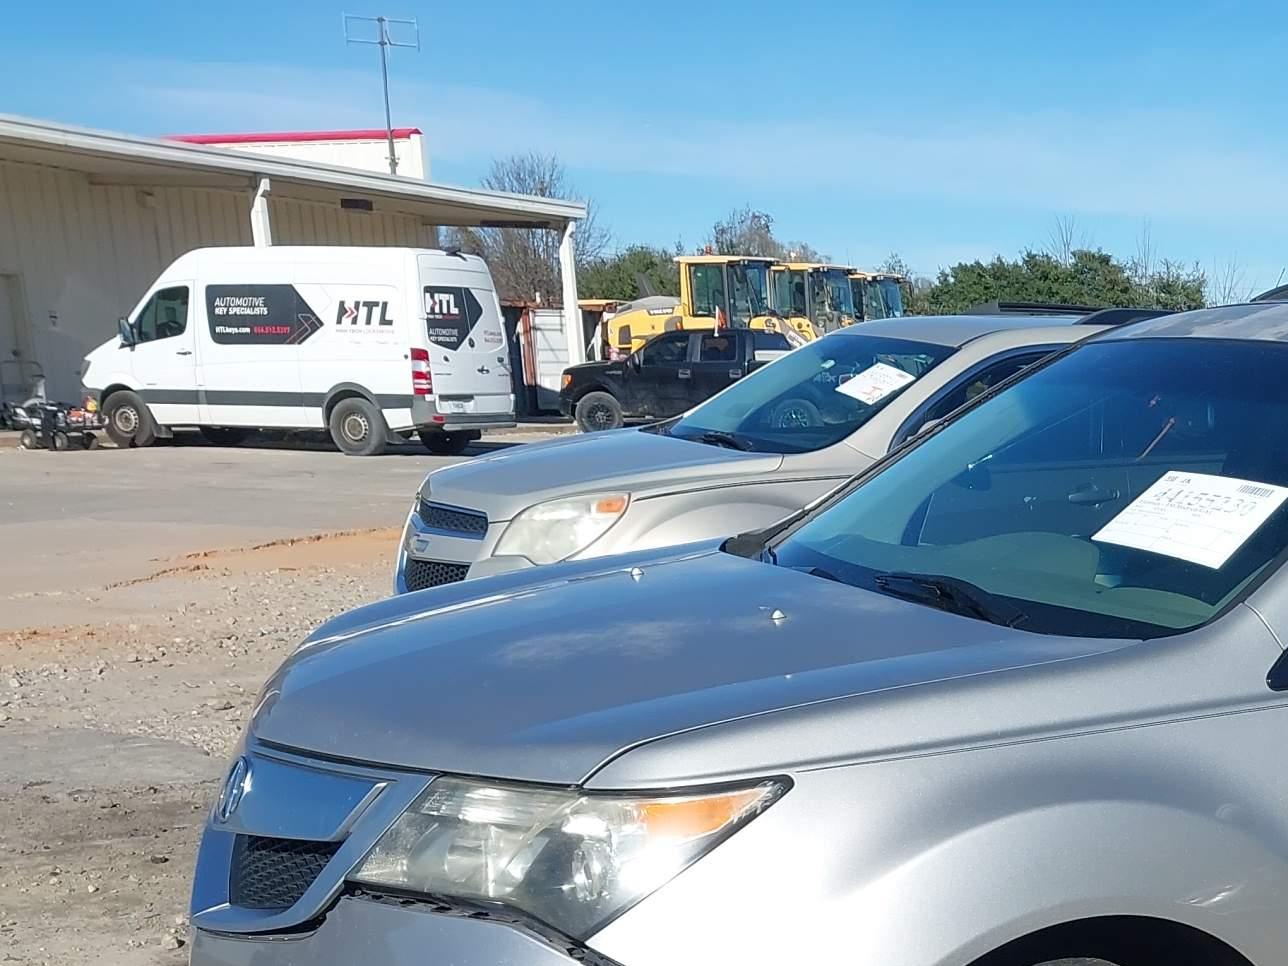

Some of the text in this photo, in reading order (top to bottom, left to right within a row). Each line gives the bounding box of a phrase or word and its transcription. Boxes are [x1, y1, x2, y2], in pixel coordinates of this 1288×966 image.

[214, 296, 265, 307] AUTOMOTIVE
[425, 292, 459, 315] HTL
[214, 307, 268, 315] KEY SPECIALISTS
[336, 300, 394, 326] HTL
[429, 327, 459, 337] AUTOMOTIVE
